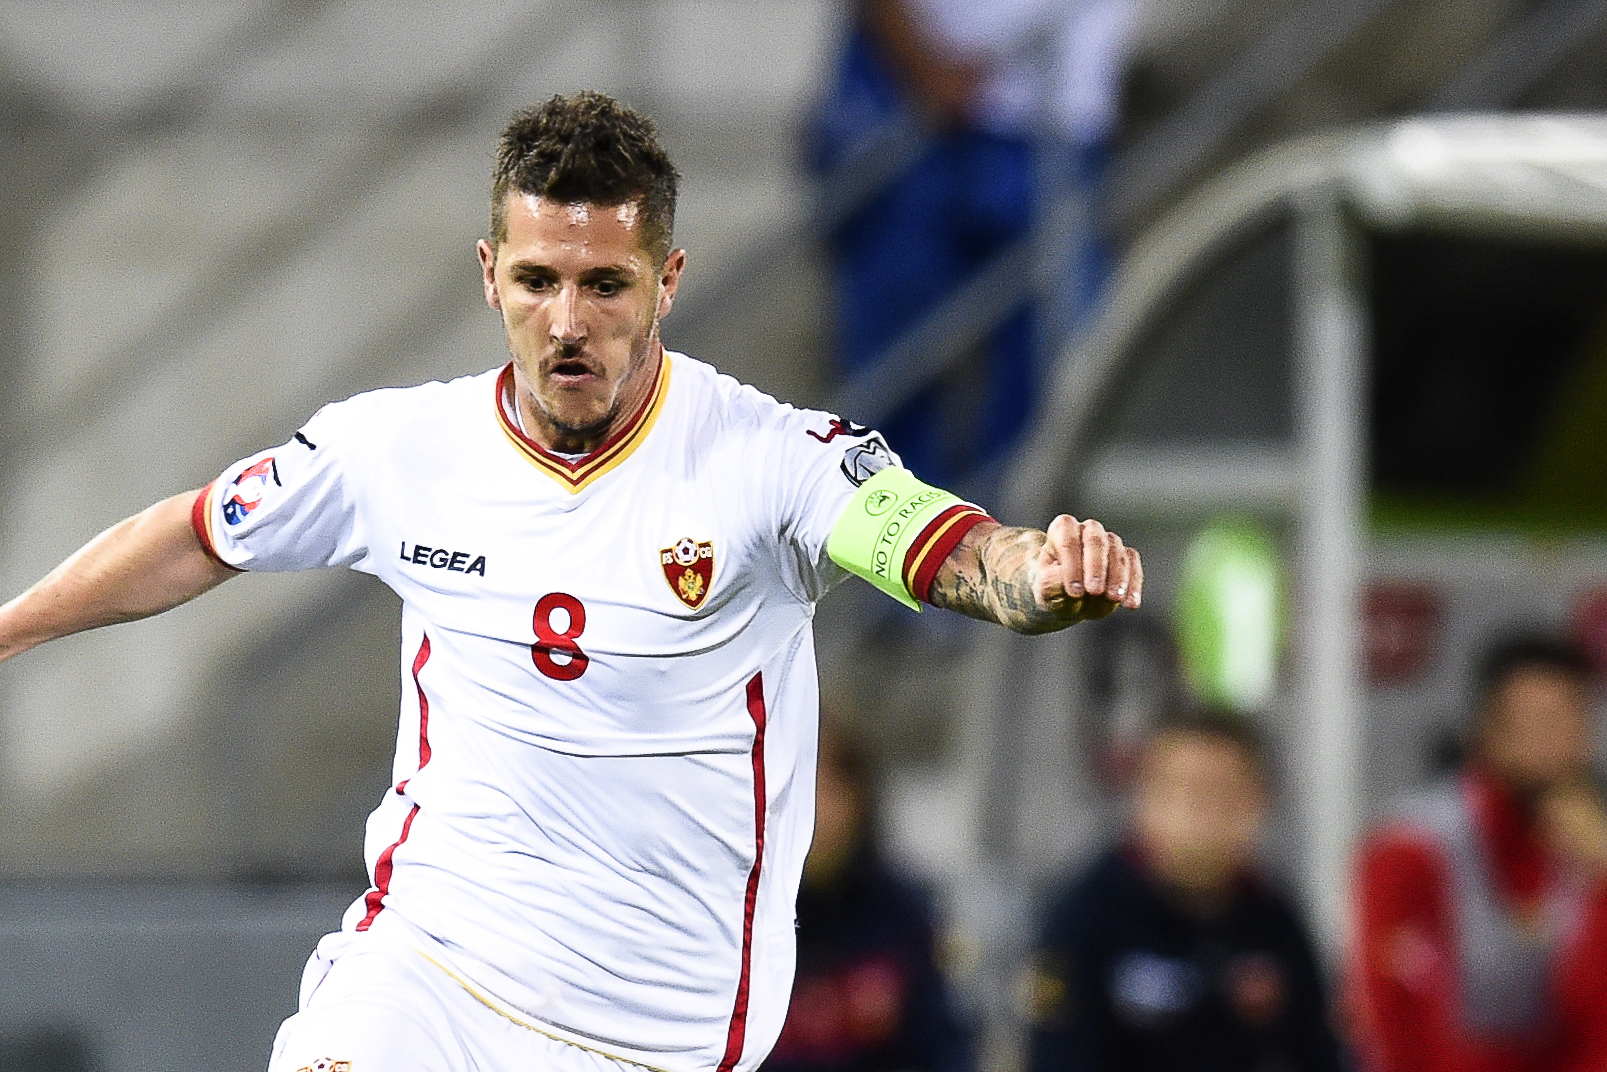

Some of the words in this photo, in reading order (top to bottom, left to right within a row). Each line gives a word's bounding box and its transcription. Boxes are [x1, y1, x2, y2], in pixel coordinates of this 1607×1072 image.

[898, 491, 946, 519] RACIS
[881, 522, 900, 546] TO
[400, 541, 486, 577] LEGEA
[876, 551, 888, 578] NO
[531, 591, 590, 682] 8
